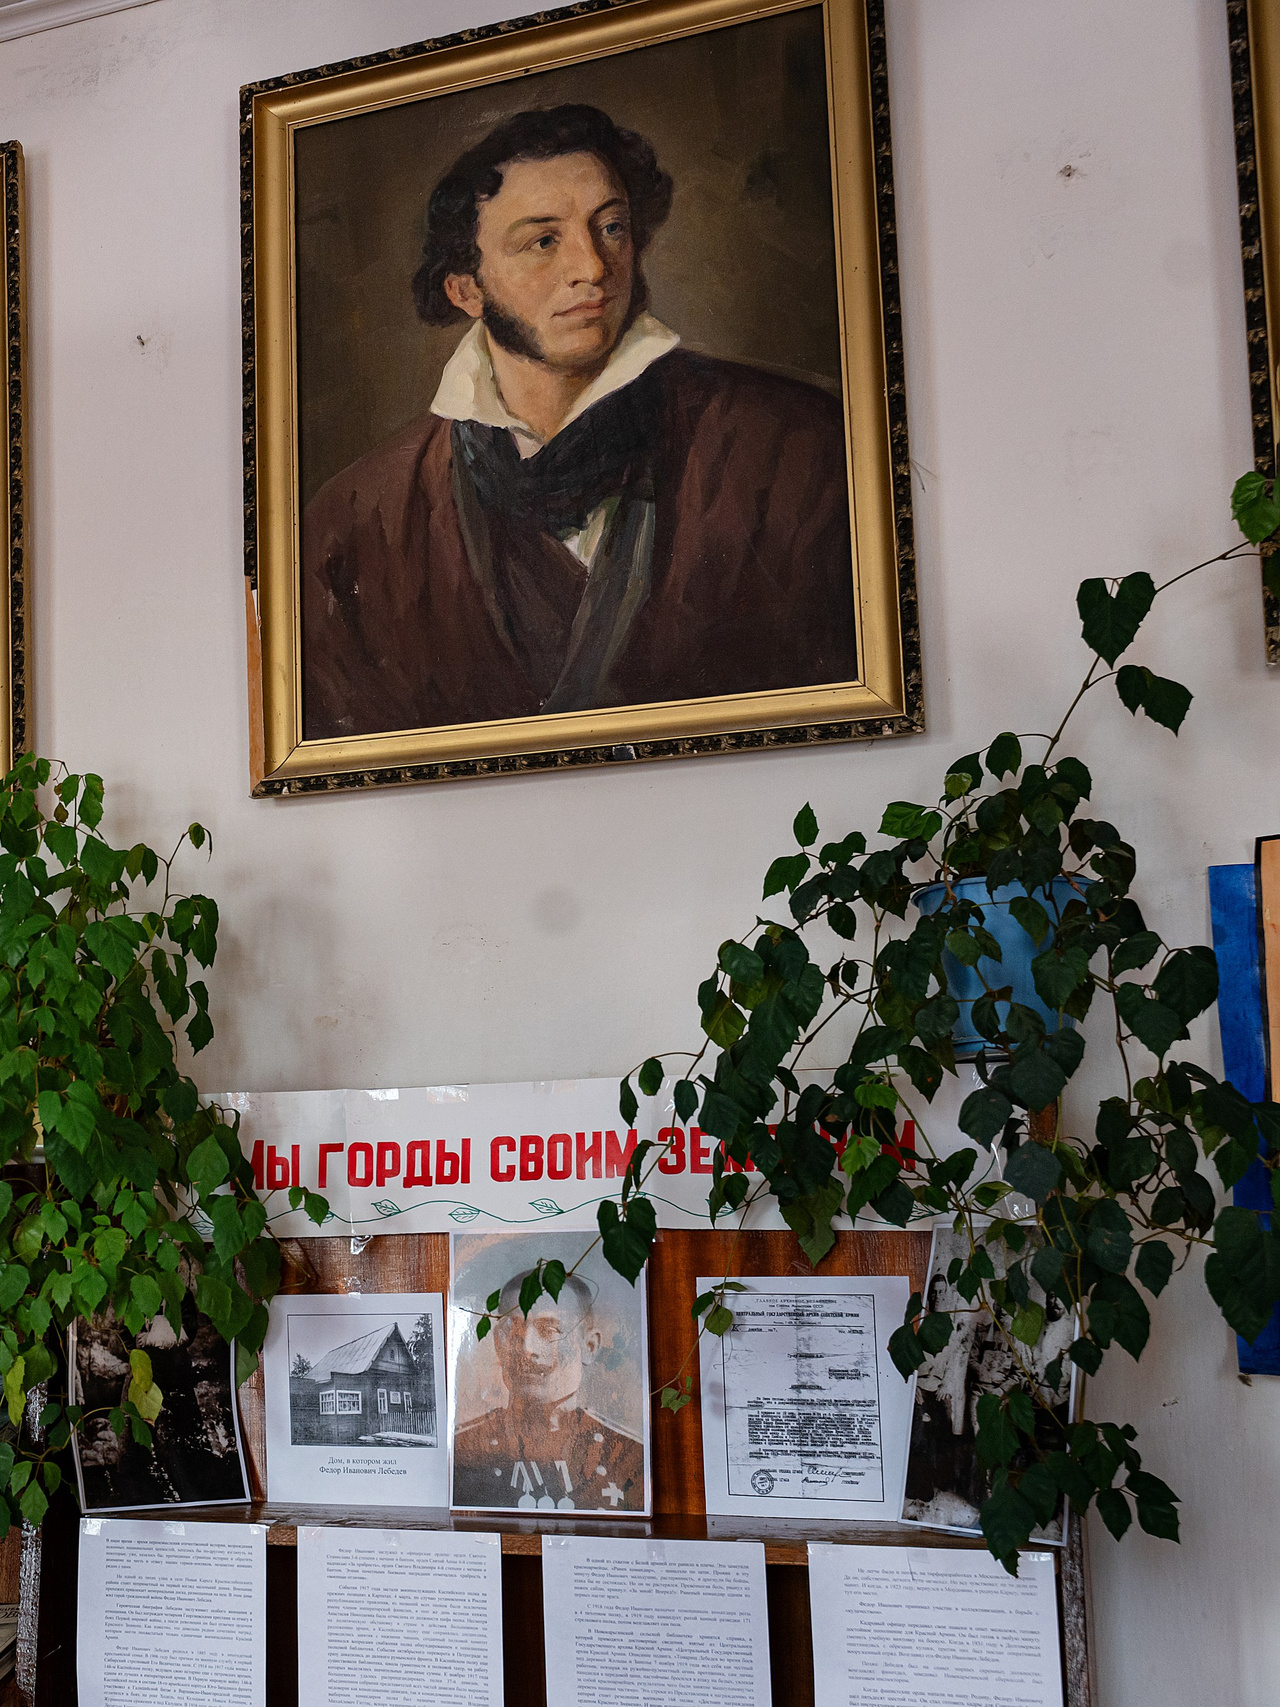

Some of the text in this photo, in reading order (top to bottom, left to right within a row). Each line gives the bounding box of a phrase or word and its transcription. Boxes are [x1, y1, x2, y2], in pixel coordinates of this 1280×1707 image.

[318, 1137, 472, 1189] ГОРДЫ
[489, 1128, 638, 1183] СВОИМ
[328, 1457, 345, 1465] Дом,
[377, 1467, 407, 1475] Лебедев
